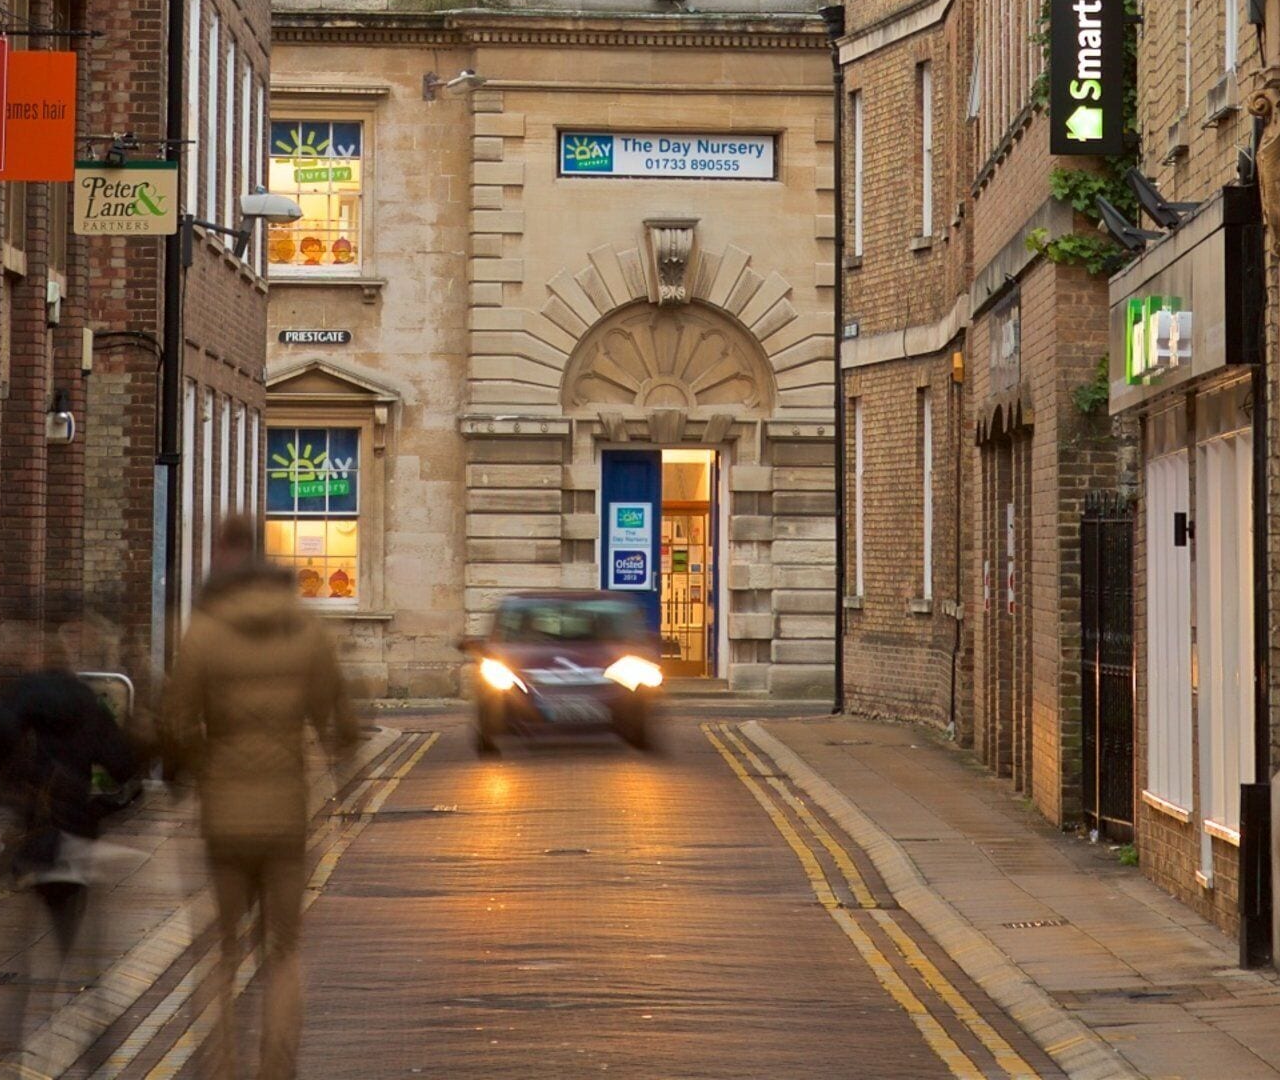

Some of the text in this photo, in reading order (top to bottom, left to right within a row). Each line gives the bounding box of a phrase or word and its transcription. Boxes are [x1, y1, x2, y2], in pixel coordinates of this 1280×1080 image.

[1069, 0, 1103, 101] Smart
[6, 99, 67, 120] ames hair
[575, 141, 612, 160] DAY
[621, 138, 765, 159] The Day Nursery
[645, 158, 741, 171] 01733 890555
[297, 169, 350, 182] nursery
[81, 176, 150, 199] Peter
[85, 198, 136, 219] Lane
[82, 221, 150, 232] PARTNERS
[284, 331, 345, 343] PRIESTGATE
[289, 456, 353, 482] DAY
[295, 483, 347, 495] nursery
[616, 559, 644, 569] Ofsted
